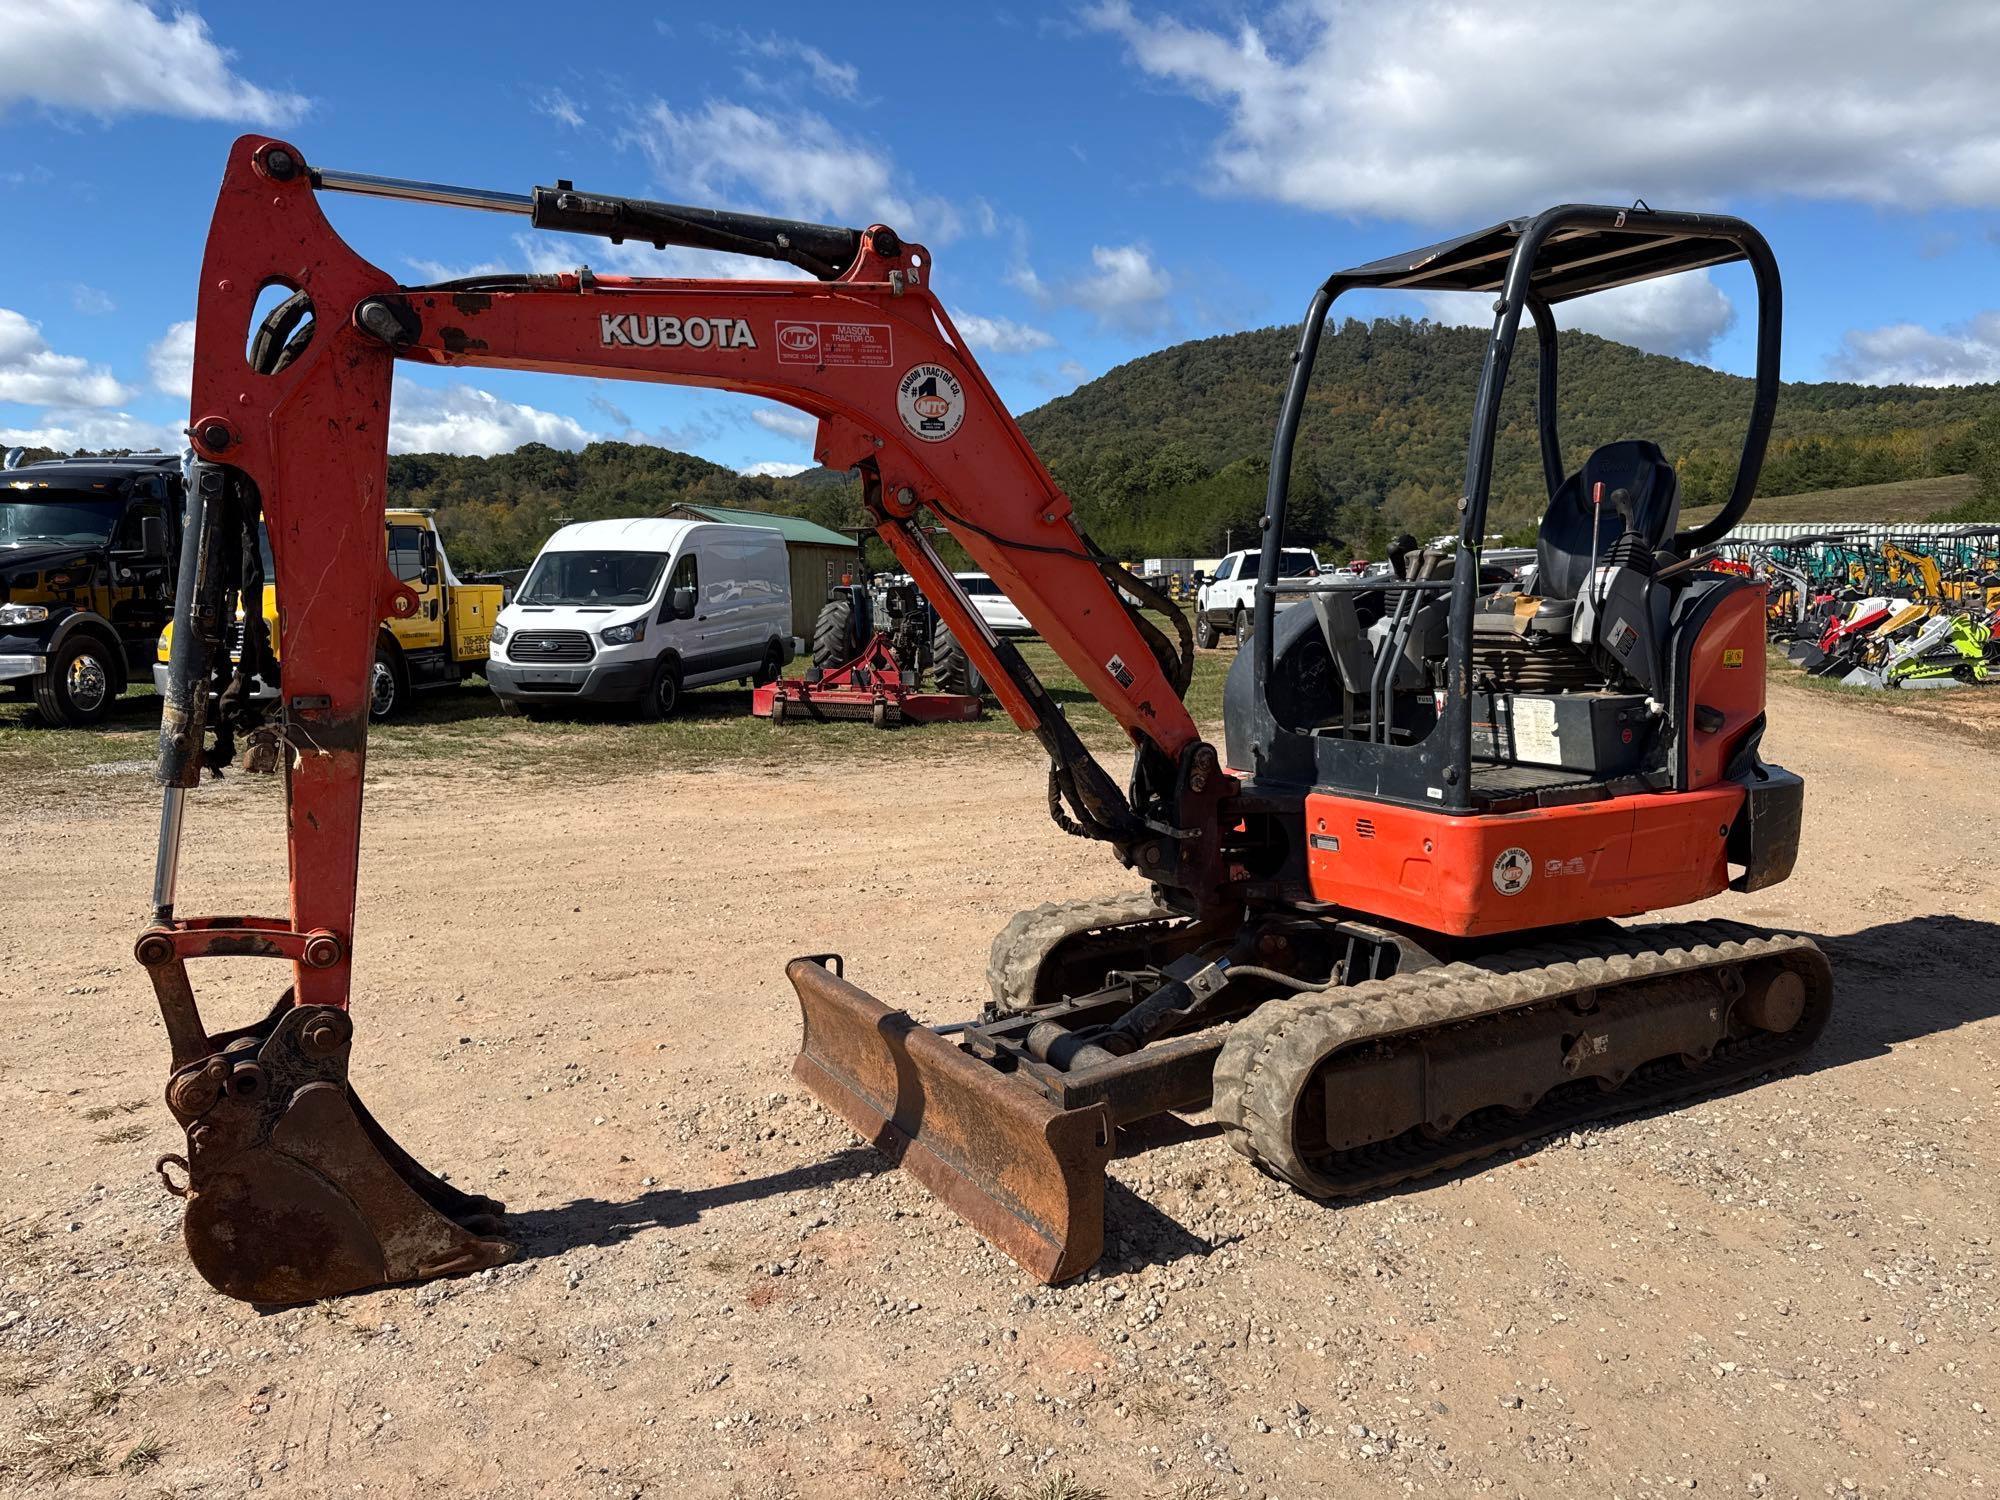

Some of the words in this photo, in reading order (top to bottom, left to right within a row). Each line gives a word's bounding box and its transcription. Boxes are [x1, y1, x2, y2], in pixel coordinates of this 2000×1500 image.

[600, 313, 757, 349] KUBOTA
[781, 331, 814, 346] MTC
[831, 334, 863, 342] TRACTOR
[837, 326, 870, 336] MASON
[901, 369, 921, 394] MASON
[921, 366, 954, 385] TRACTOR
[950, 382, 960, 398] CO.
